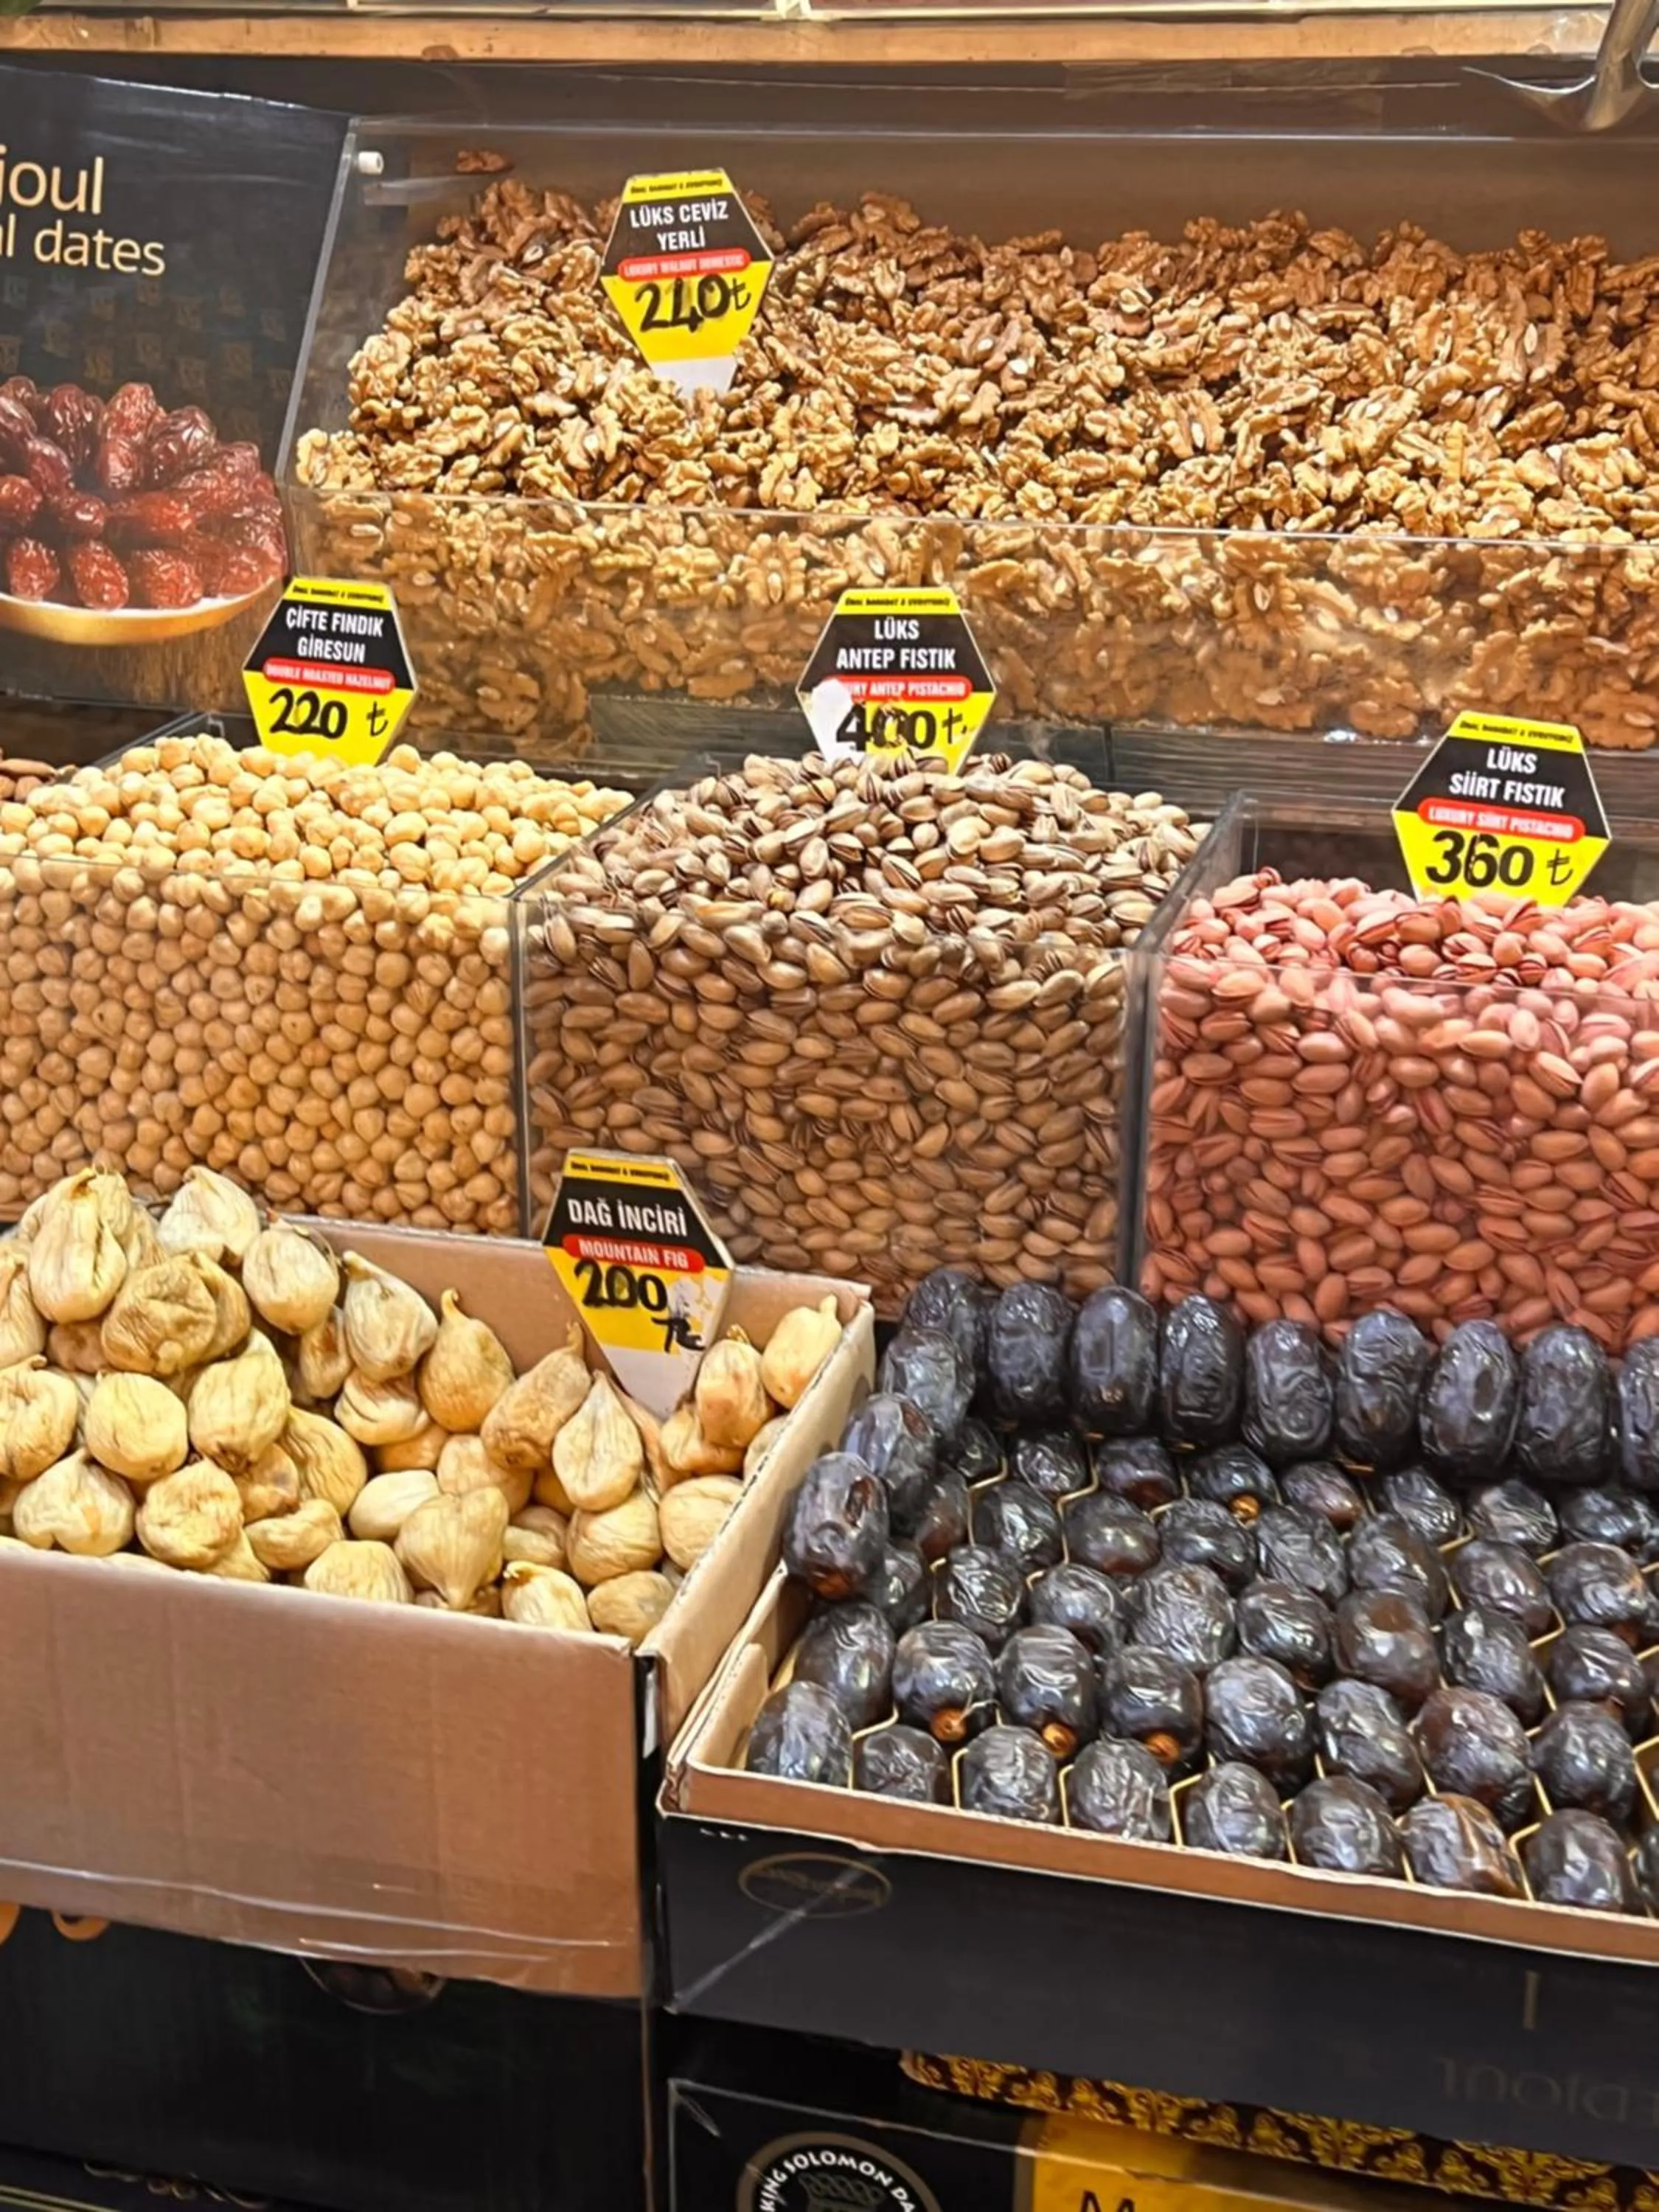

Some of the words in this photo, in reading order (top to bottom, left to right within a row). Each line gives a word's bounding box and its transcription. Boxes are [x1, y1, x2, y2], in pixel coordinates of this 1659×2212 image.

[630, 204, 674, 228] LÜKS
[679, 198, 728, 223] CEVİZ
[34, 219, 166, 276] dates
[657, 225, 706, 251] YERLİ
[286, 605, 328, 631] ÇİFTE
[332, 611, 384, 637] FINDIK
[874, 616, 919, 640] LÜKS
[297, 634, 366, 664] GİRESUN
[836, 648, 895, 669] ANTEP
[900, 648, 956, 669] FISTIK
[269, 688, 348, 740] 220
[1486, 746, 1537, 773] LÜKS
[1449, 771, 1500, 800] SİİRT
[1503, 781, 1565, 809] FISTIK
[1425, 830, 1534, 888] 360
[567, 1196, 613, 1228] DAĞ
[619, 1200, 688, 1237] İNCİRİ
[579, 1239, 661, 1266] MOUNTAIN
[664, 1249, 689, 1270] FIG
[574, 1258, 668, 1312] 200
[759, 2167, 788, 2212] KING
[783, 2149, 894, 2188] SOLOMON
